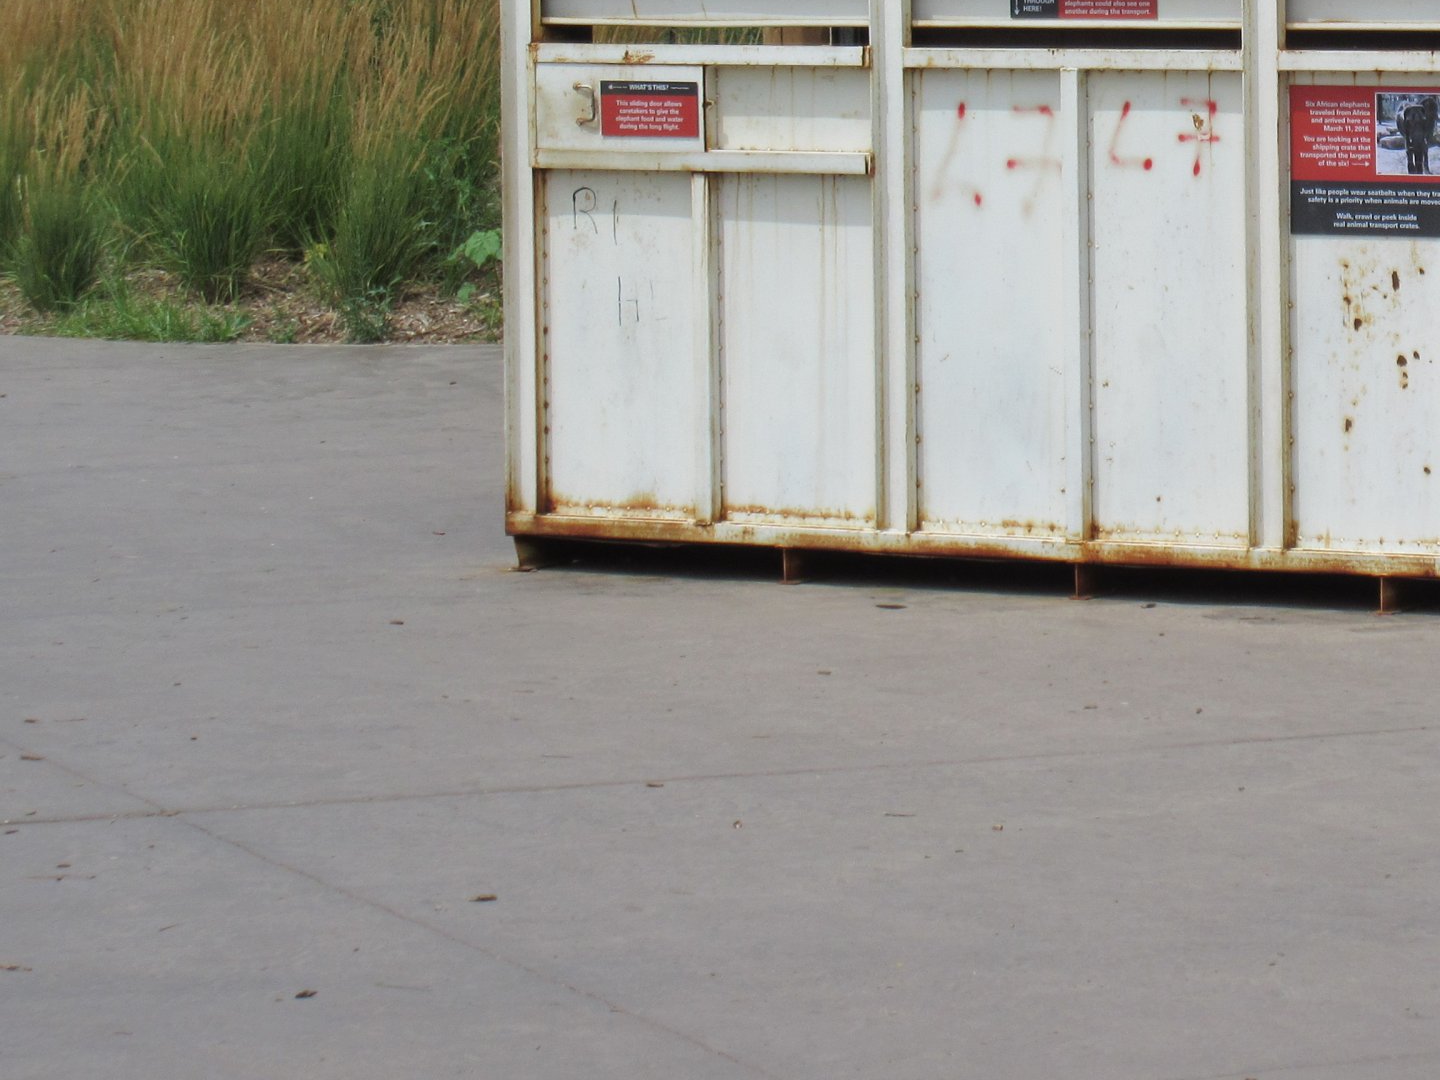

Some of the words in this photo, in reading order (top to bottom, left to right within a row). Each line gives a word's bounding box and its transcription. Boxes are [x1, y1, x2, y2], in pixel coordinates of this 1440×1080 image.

[1064, 0, 1094, 8] elephants
[1327, 136, 1351, 144] looking
[1312, 144, 1340, 152] shipping
[1299, 152, 1337, 160] transported
[1349, 152, 1371, 161] largest
[1299, 188, 1315, 196] Just
[1327, 189, 1349, 197] people
[1367, 189, 1397, 197] seatbelts
[1416, 190, 1431, 199] they
[1307, 196, 1327, 204] safety
[1340, 196, 1363, 205] priority
[1364, 197, 1383, 205] when
[1383, 197, 1409, 205] animals
[1336, 212, 1354, 221] Walk,
[1354, 213, 1373, 221] crawl
[1381, 213, 1398, 222] peek
[1398, 213, 1418, 221] inside
[1333, 220, 1346, 228] real
[1369, 221, 1399, 230] transport
[1399, 222, 1420, 230] crates.
